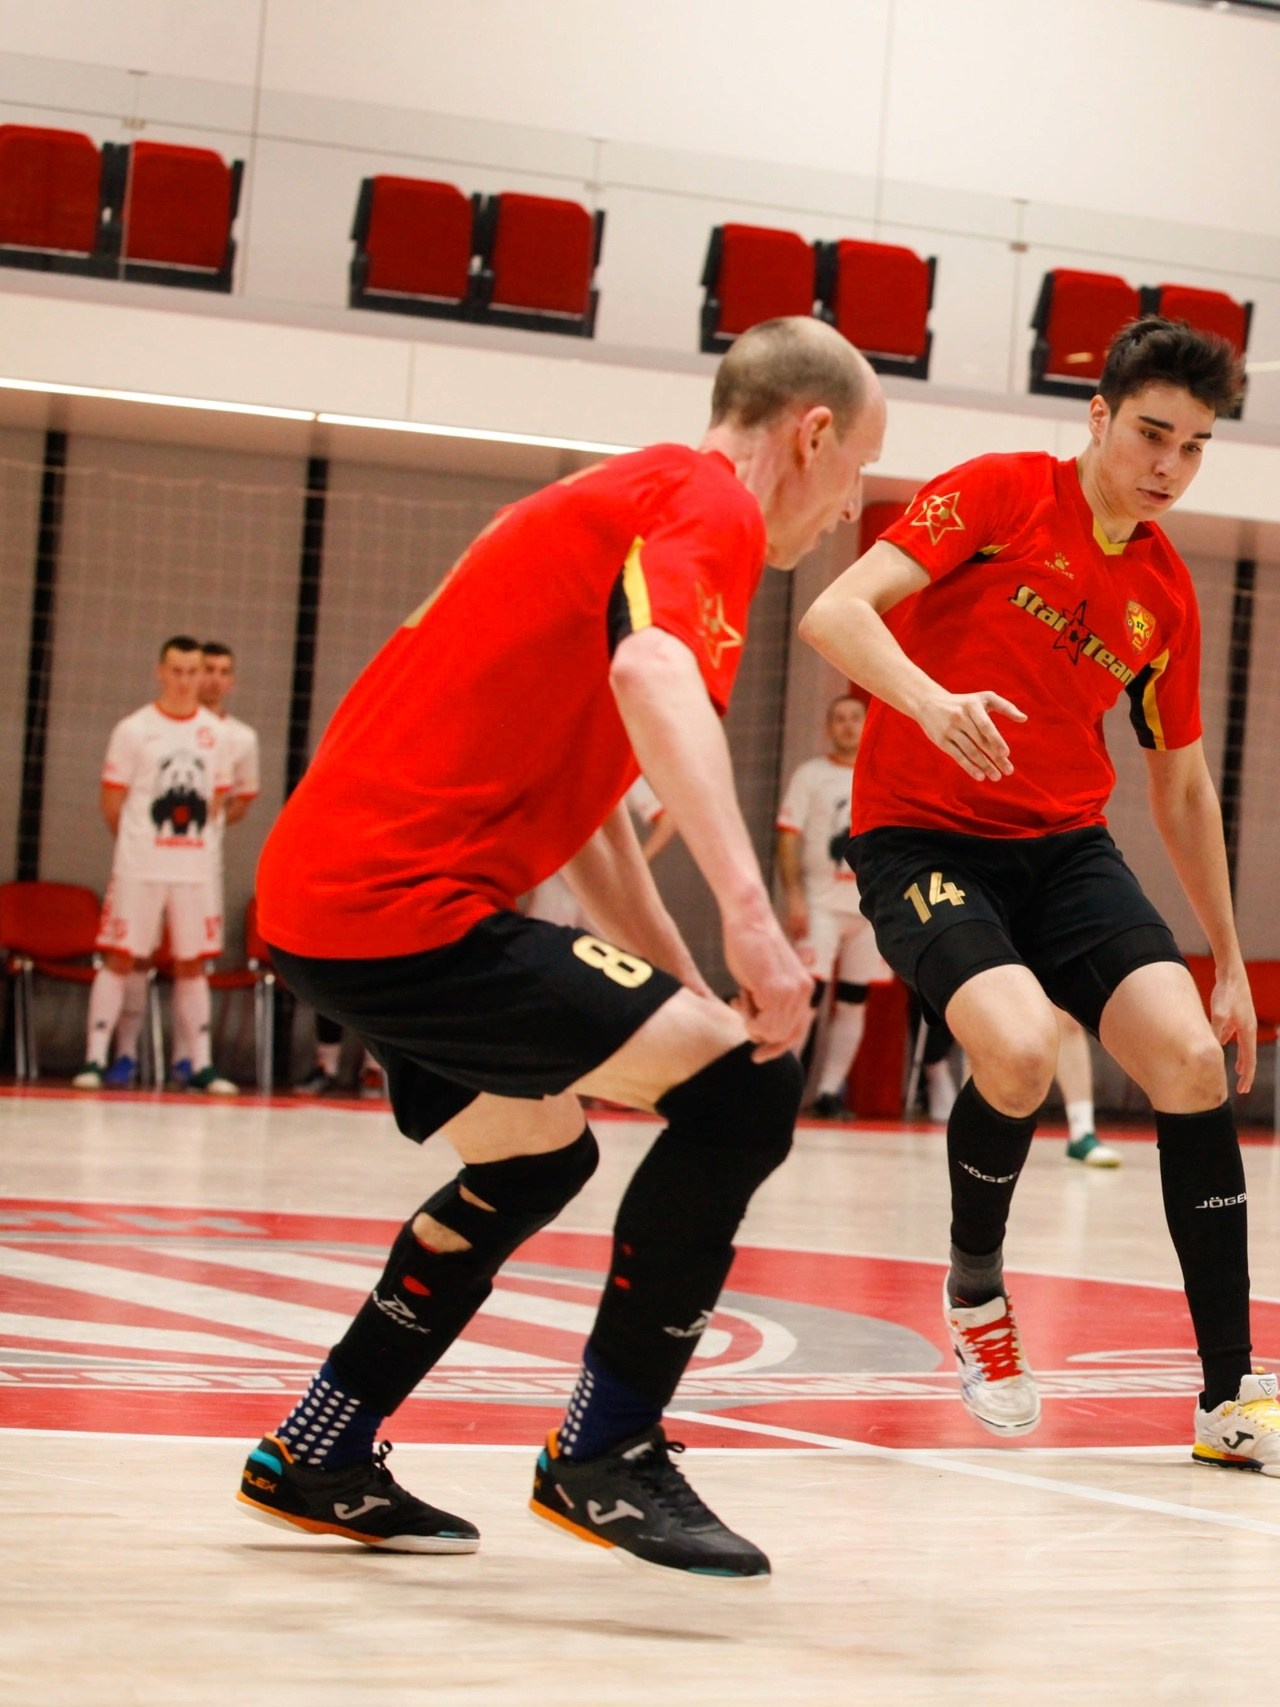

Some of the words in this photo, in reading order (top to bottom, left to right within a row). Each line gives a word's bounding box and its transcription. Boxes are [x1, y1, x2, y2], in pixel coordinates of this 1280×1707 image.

[1008, 584, 1068, 632] Star
[1081, 633, 1137, 686] Team
[903, 872, 966, 924] 14
[572, 934, 654, 989] 8
